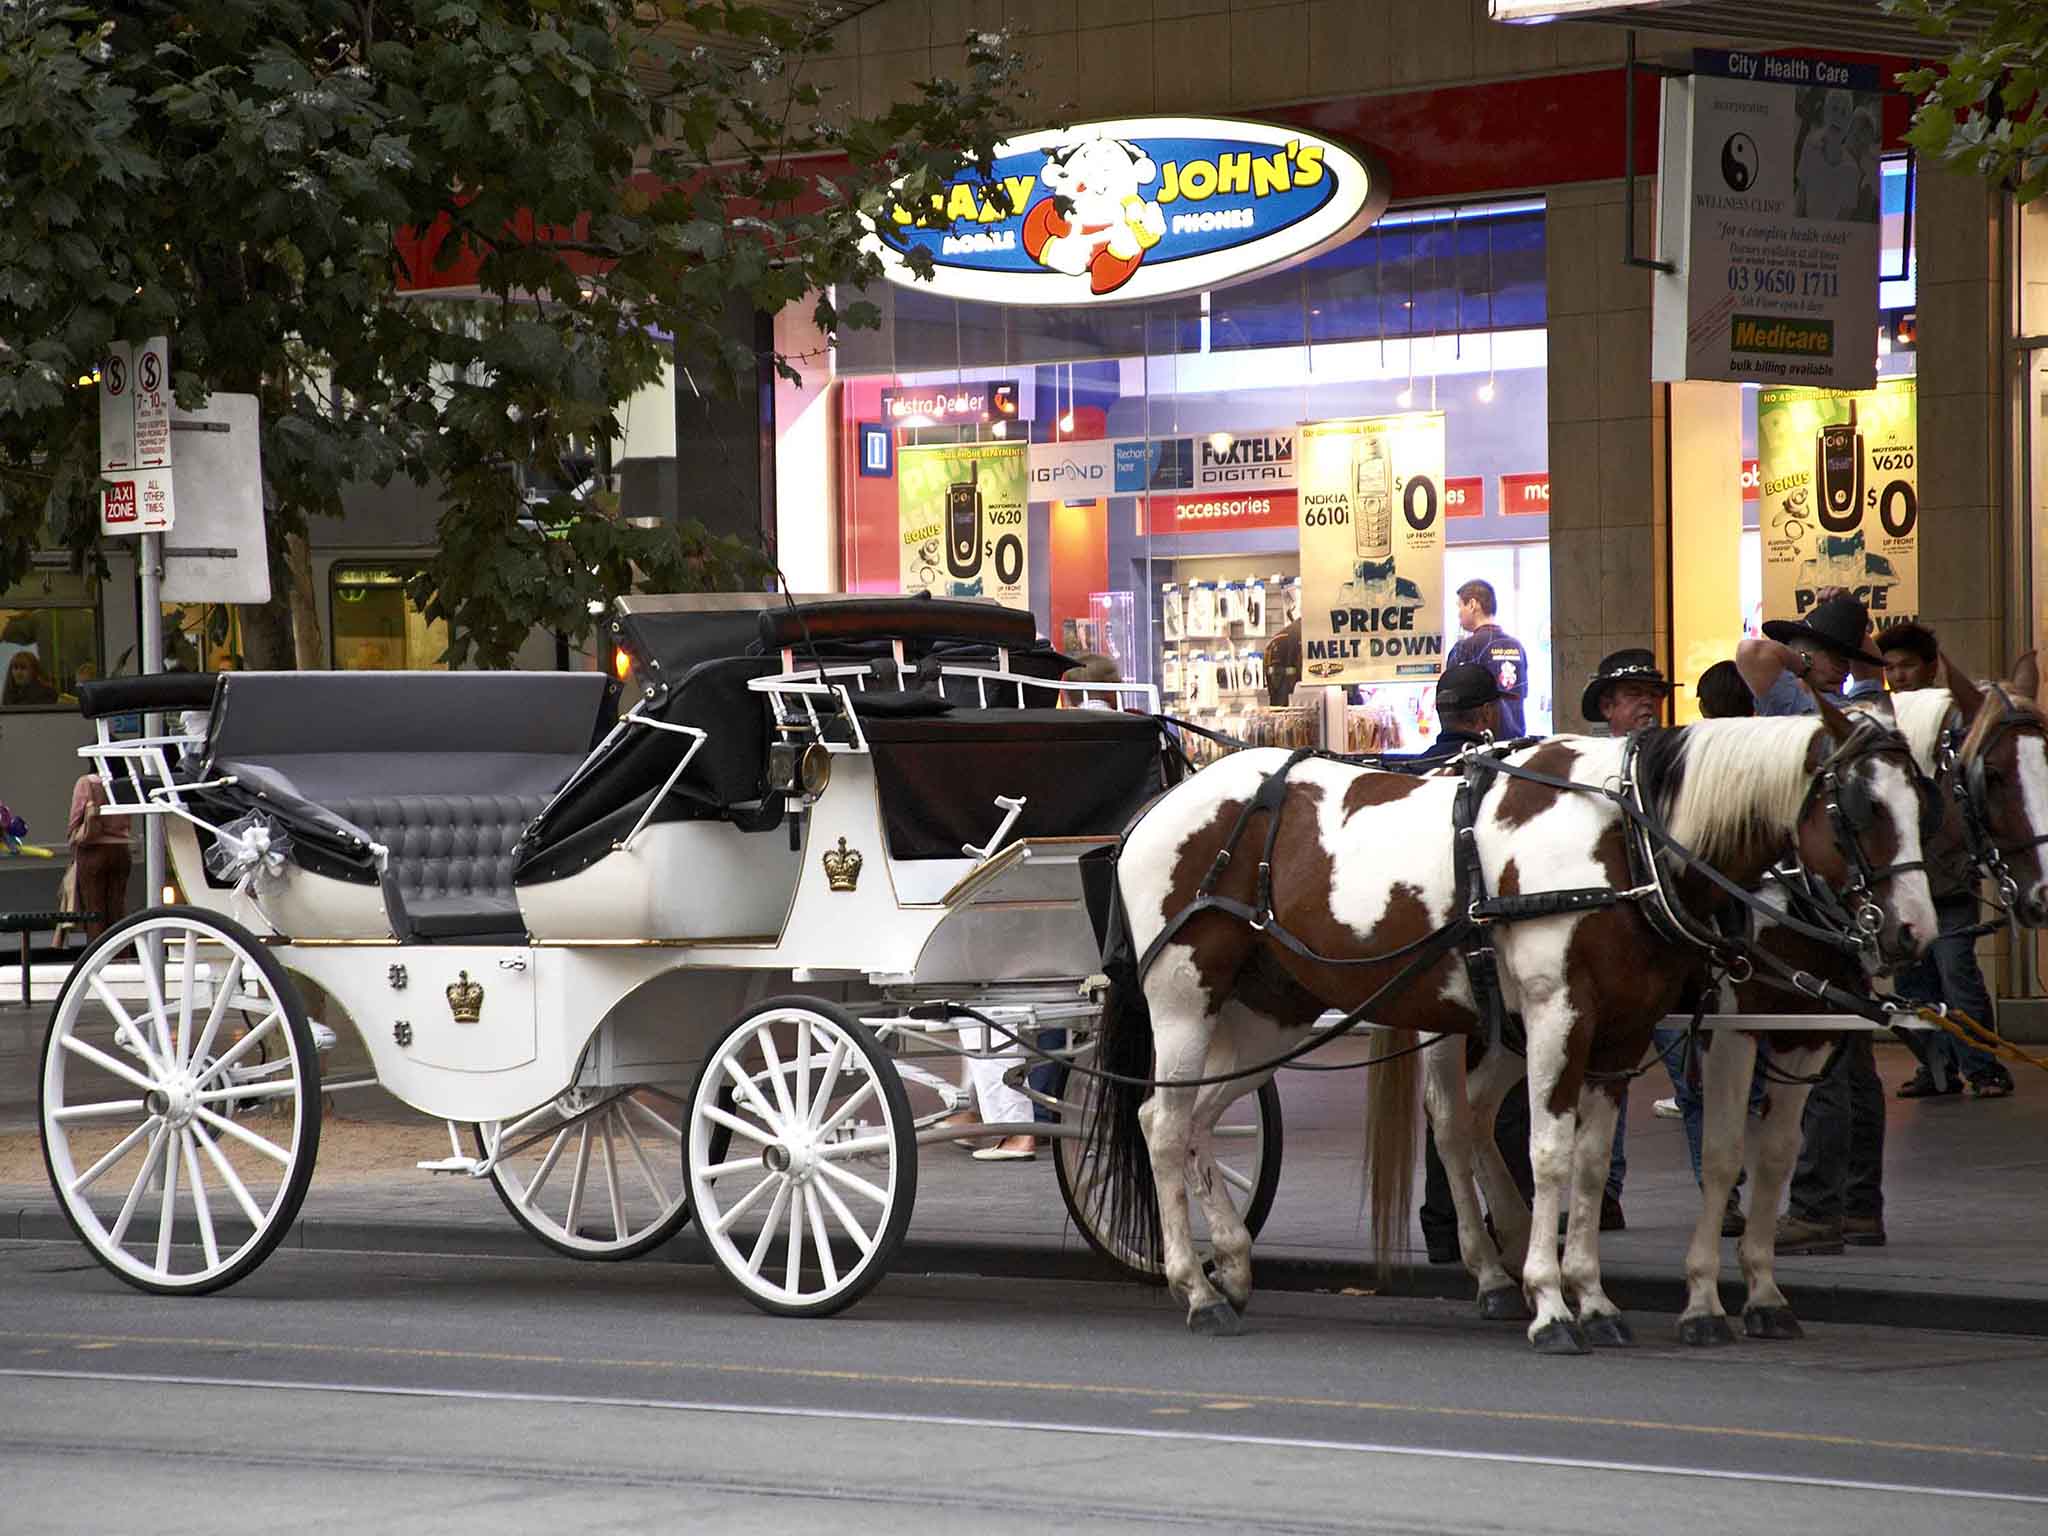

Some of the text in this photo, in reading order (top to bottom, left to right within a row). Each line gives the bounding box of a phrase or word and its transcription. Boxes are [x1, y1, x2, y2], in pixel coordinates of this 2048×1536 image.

[1728, 53, 1849, 84] City Health Care
[1156, 140, 1326, 203] JOHN'S
[1173, 208, 1254, 235] PHONES
[1728, 266, 1840, 297] 03 9650 1711
[1736, 321, 1829, 350] Medicare
[1730, 359, 1834, 376] bulk billing available
[1872, 454, 1914, 471] V620
[147, 479, 159, 490] ALL
[1202, 467, 1293, 482] DIGITAL
[1764, 471, 1810, 496] BONUS
[143, 490, 165, 502] OTHER
[144, 501, 164, 513] TIMES
[1304, 494, 1349, 505] NOKIA
[107, 502, 133, 518] ZONE
[989, 510, 1022, 525] V620
[1176, 496, 1271, 520] accessories
[1304, 505, 1349, 527] 6610i
[904, 523, 941, 545] BONUS
[1330, 606, 1416, 634] PRICE
[1307, 635, 1442, 660] MELT DOWN
